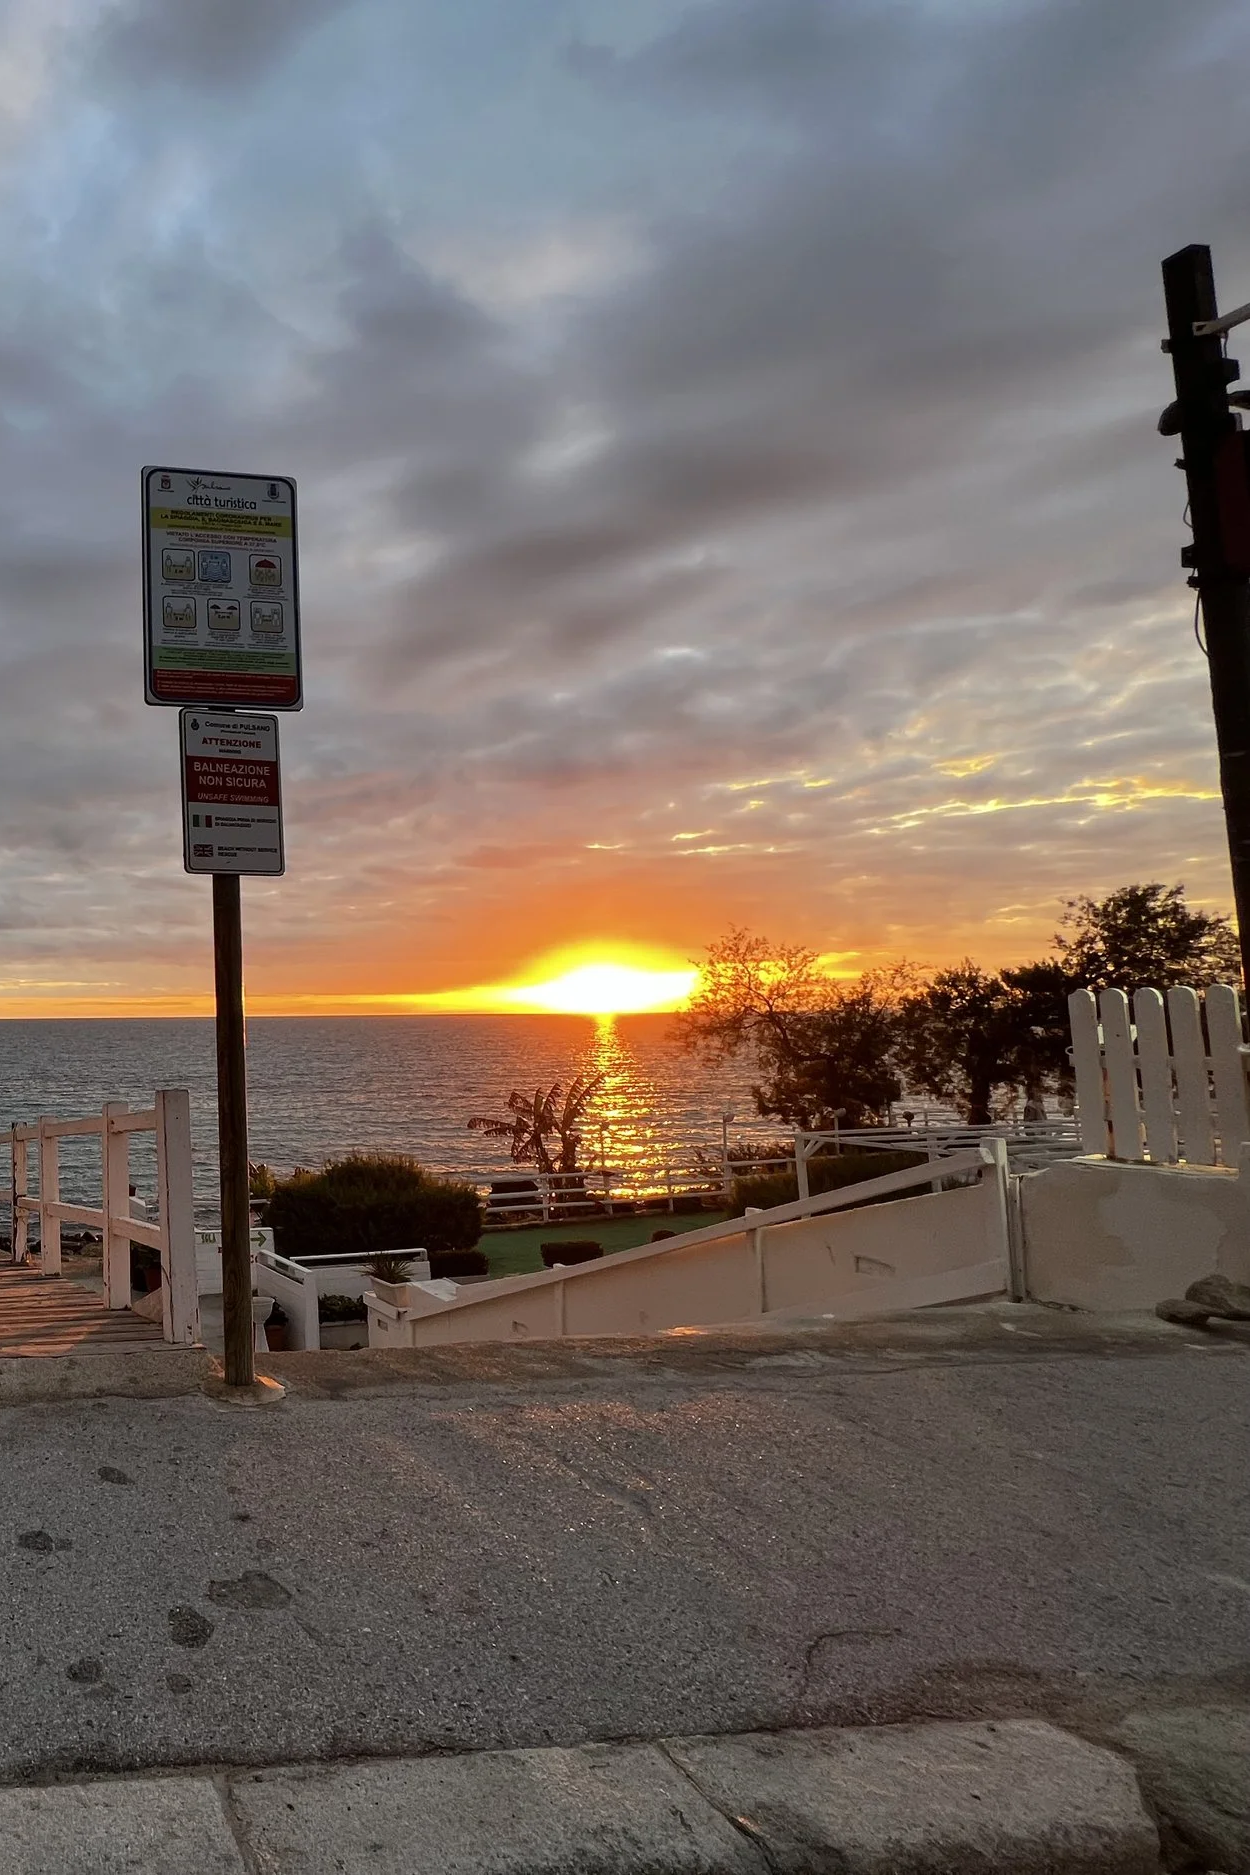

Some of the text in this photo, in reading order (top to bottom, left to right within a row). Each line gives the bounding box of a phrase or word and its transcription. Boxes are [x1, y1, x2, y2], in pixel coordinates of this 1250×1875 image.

[187, 494, 257, 510] città turistica
[205, 721, 231, 730] Comune
[239, 724, 271, 732] PULSANO
[201, 737, 262, 749] ATTENZIONE
[193, 762, 271, 776] BALNEAZIONE
[199, 776, 267, 789] NON SICURA
[197, 793, 270, 804] UNSAFE SWIMMING
